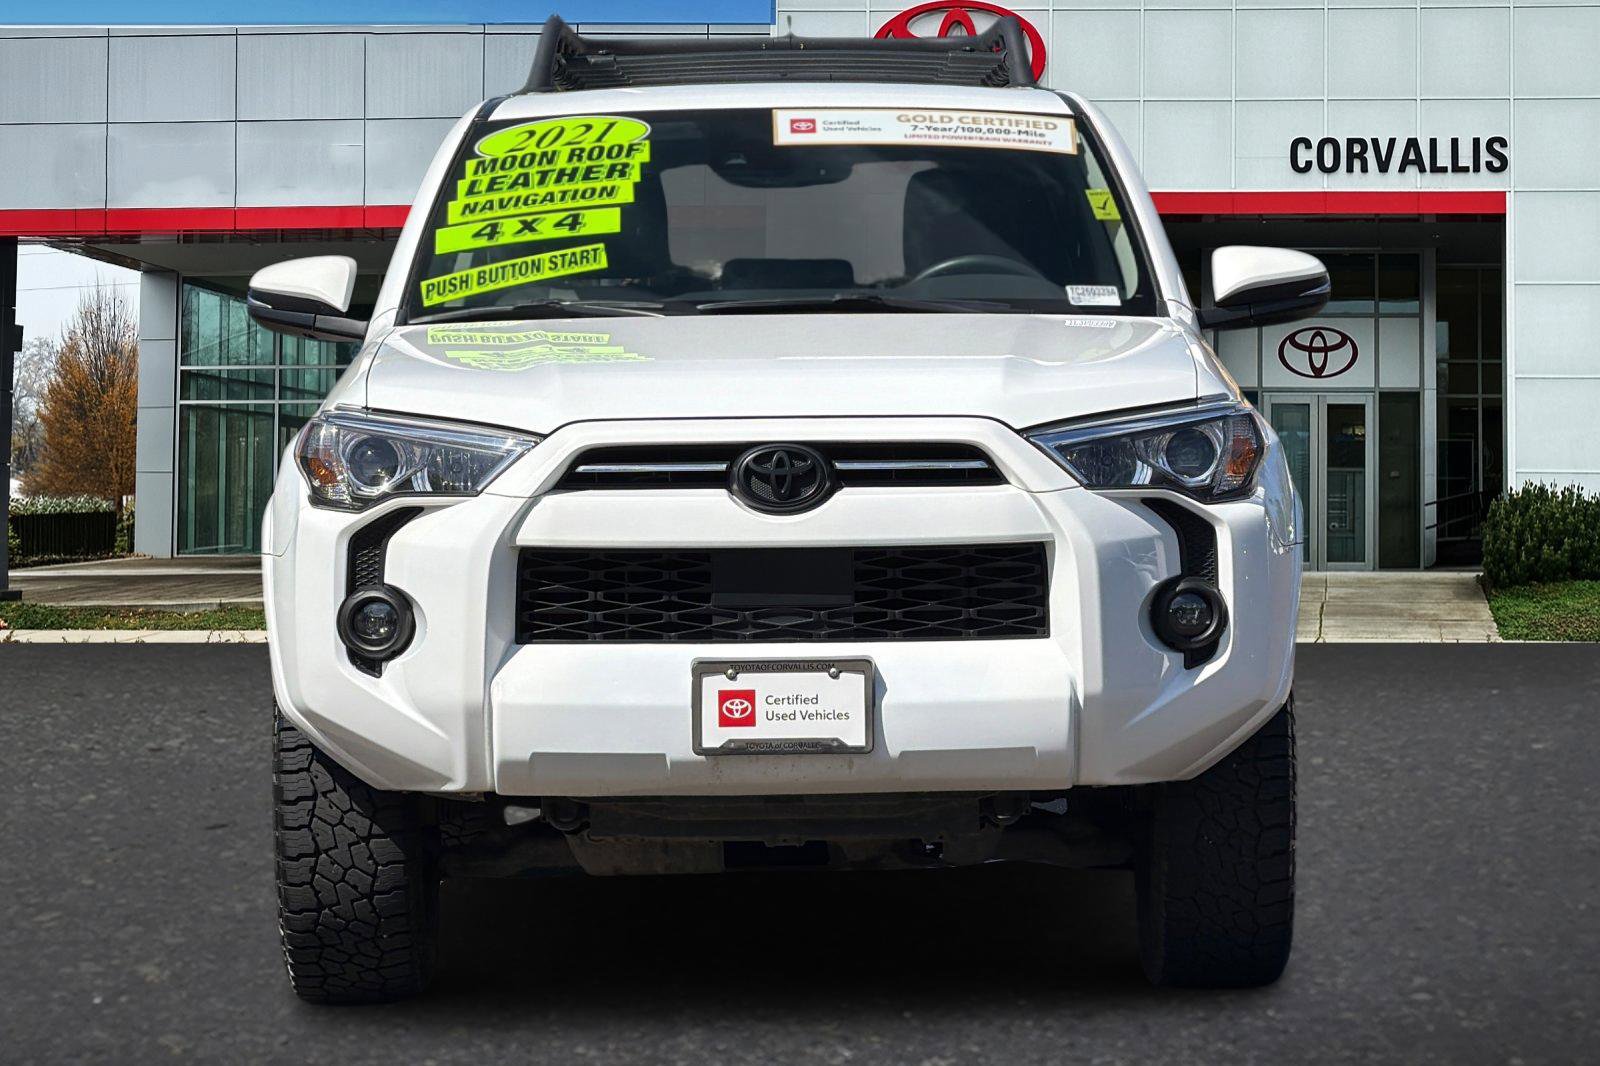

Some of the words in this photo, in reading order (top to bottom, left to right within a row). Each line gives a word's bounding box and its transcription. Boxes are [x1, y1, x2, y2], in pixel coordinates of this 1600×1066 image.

[504, 121, 618, 153] 2021
[896, 114, 954, 124] GOLD
[958, 115, 1059, 131] CERTIFIED
[911, 124, 1046, 138] 7-Year/100,000-Mile
[472, 149, 559, 177] MOON
[567, 142, 645, 165] ROOF
[1290, 136, 1509, 174] CORVALLIS
[465, 162, 633, 198] LEATHER
[461, 185, 618, 217] NAVIGATION
[425, 275, 471, 300] PUSH
[477, 257, 544, 287] BUTTON
[549, 247, 603, 272] START
[765, 694, 819, 705] Certified
[765, 709, 797, 721] Used
[799, 709, 850, 721] Vehicles
